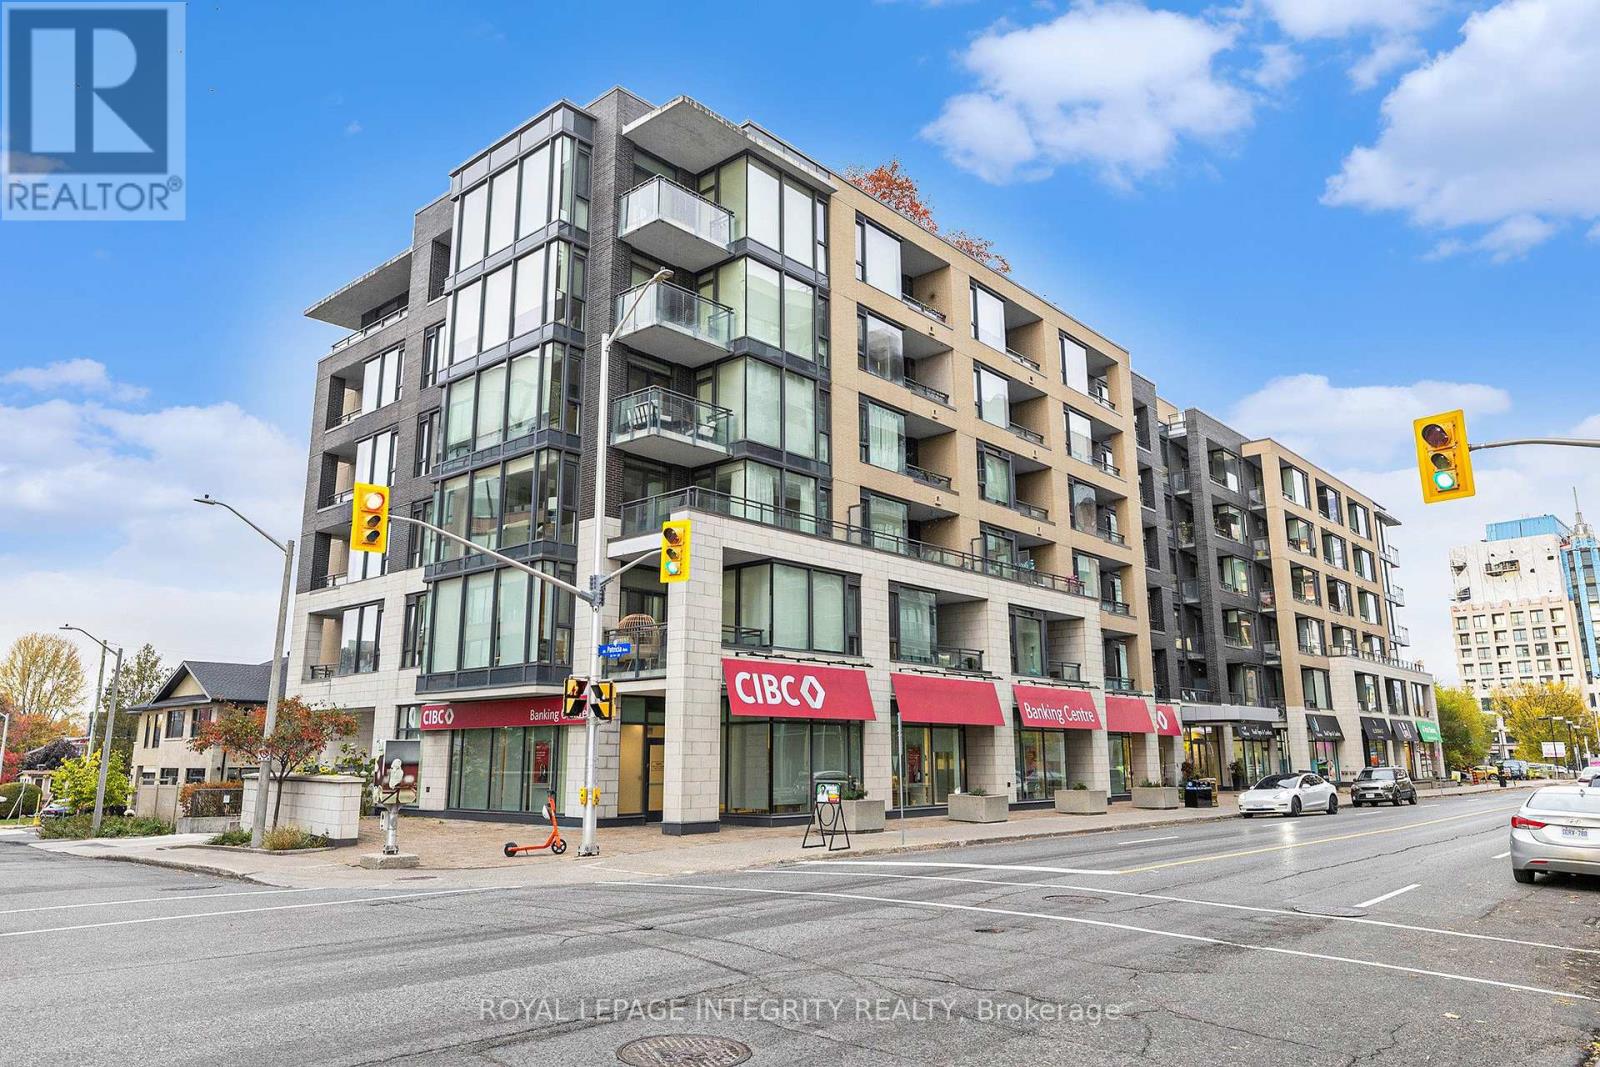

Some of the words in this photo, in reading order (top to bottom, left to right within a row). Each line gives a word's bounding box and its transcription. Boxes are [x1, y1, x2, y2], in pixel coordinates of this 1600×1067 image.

[735, 671, 801, 707] CIBC
[422, 709, 445, 725] CIBC
[529, 708, 560, 723] Banking
[1023, 701, 1065, 725] Banking
[1063, 705, 1095, 722] Centre
